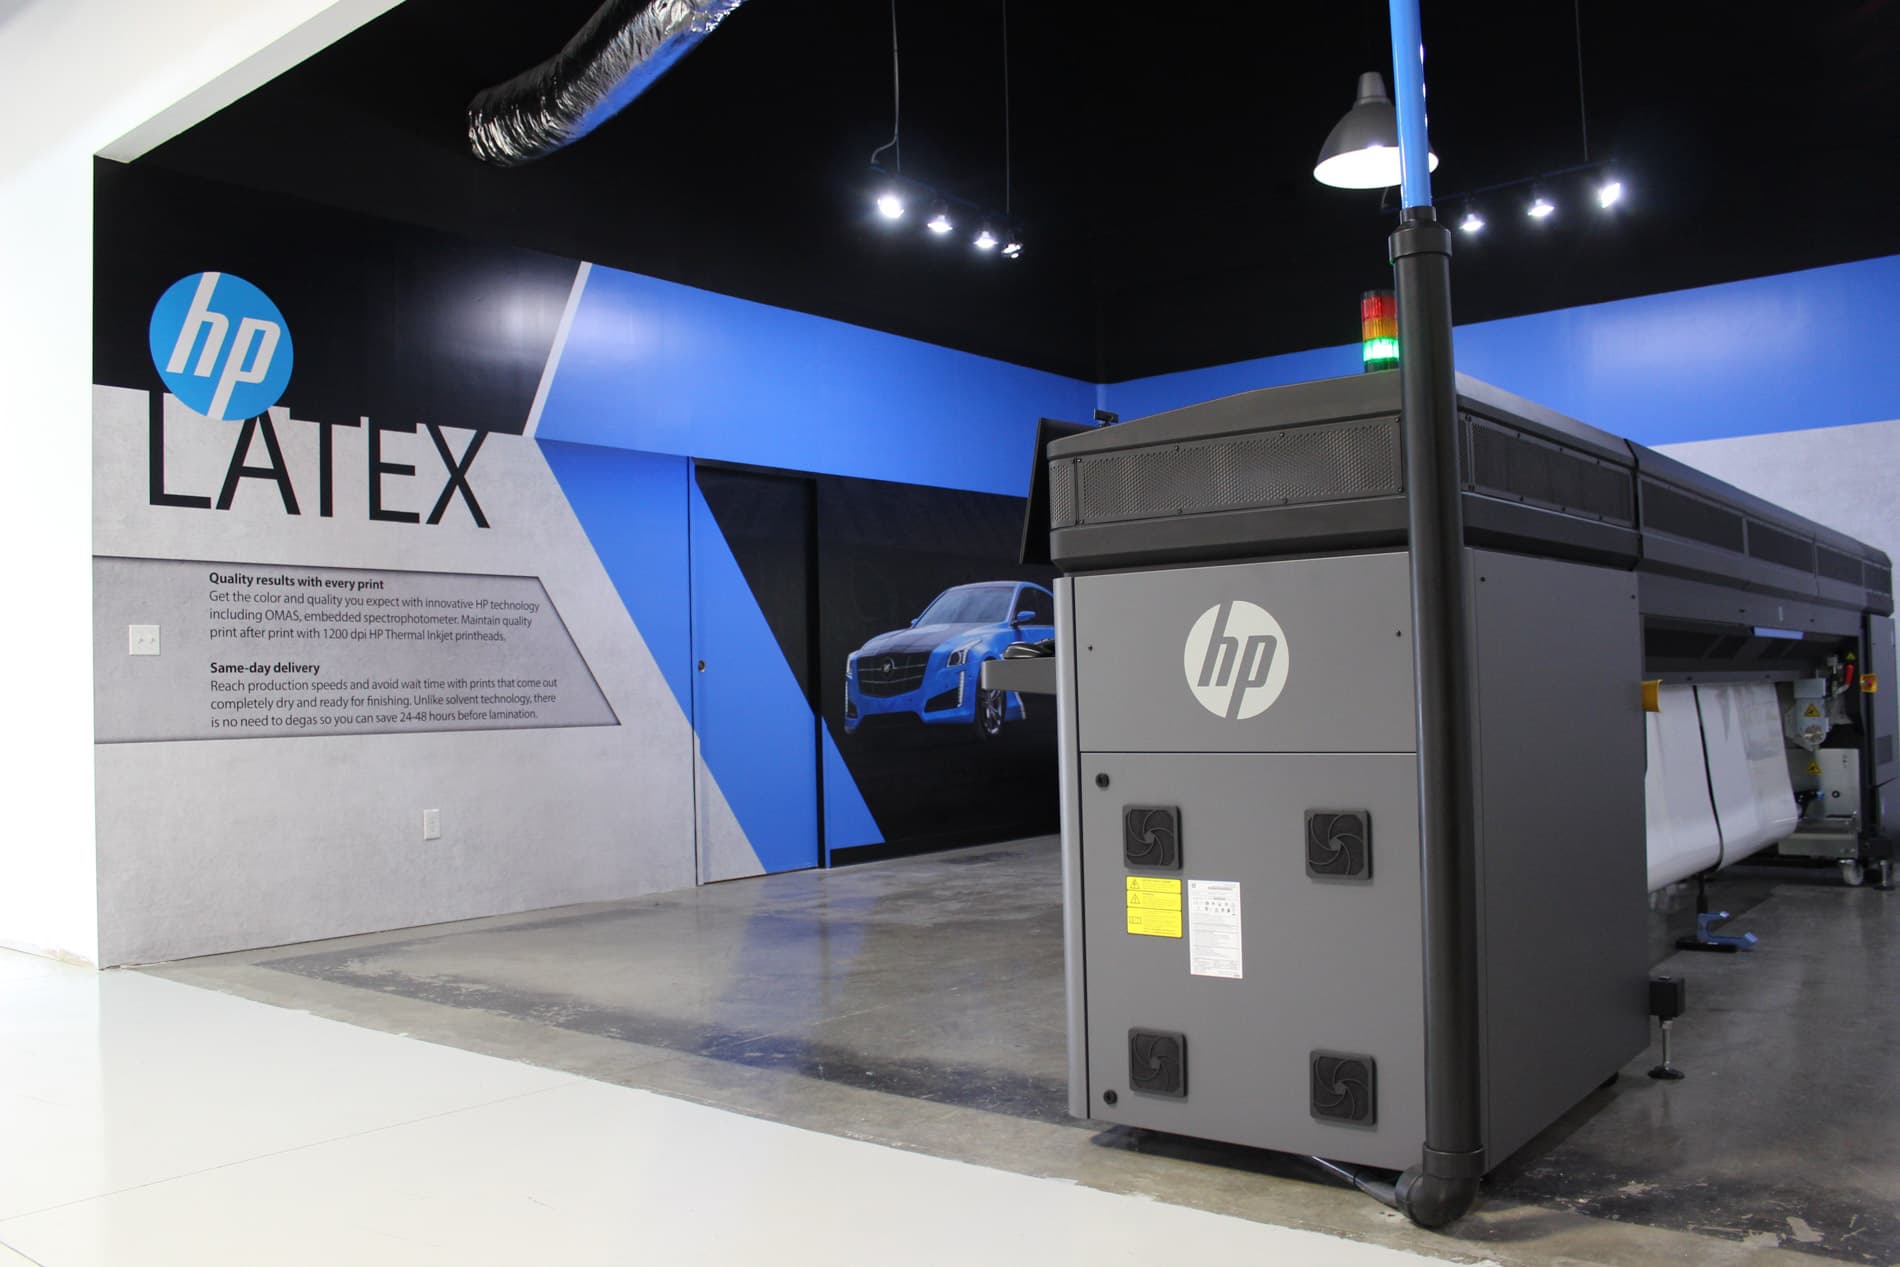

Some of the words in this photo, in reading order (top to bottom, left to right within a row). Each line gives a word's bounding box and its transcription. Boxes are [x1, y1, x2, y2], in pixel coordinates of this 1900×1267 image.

[166, 272, 281, 421] hp
[149, 386, 491, 528] LATEX
[209, 572, 253, 587] Quality
[257, 575, 295, 586] results
[298, 576, 322, 587] with
[325, 579, 355, 591] every
[358, 578, 384, 591] print
[209, 591, 230, 602] Get
[233, 591, 250, 602] the
[254, 592, 280, 603] color
[284, 593, 304, 604] and
[307, 595, 342, 607] quality
[345, 597, 363, 607] you
[366, 598, 400, 608] expect
[402, 597, 423, 608] with
[425, 597, 474, 609] innovative
[476, 600, 488, 609] HP
[491, 600, 539, 613] technology
[209, 609, 262, 623] including
[265, 610, 302, 622] OMAS,
[304, 611, 361, 623] embedded
[364, 614, 459, 626] spectrophotometer.
[461, 616, 500, 625] Maintain
[502, 616, 532, 628] quality
[210, 628, 236, 639] print
[240, 627, 265, 638] after
[268, 628, 293, 640] print
[297, 629, 320, 639] with
[323, 629, 348, 639] 1200
[351, 630, 367, 640] dpi
[370, 630, 383, 639] HP
[386, 629, 425, 640] Thermal
[427, 630, 453, 643] Inkjet
[456, 631, 506, 642] printheads.
[210, 662, 270, 675] Same-day
[274, 662, 320, 675] delivery
[1197, 601, 1278, 720] hp
[211, 680, 245, 691] Reach
[248, 680, 308, 693] production
[312, 680, 347, 692] speeds
[350, 680, 369, 689] and
[372, 679, 399, 689] avoid
[401, 679, 421, 689] wait
[424, 679, 445, 689] time
[448, 678, 467, 688] with
[470, 679, 496, 690] prints
[498, 678, 515, 688] that
[517, 680, 541, 688] come
[543, 679, 557, 687] out
[211, 697, 273, 712] completely
[276, 697, 294, 710] dry
[297, 697, 317, 708] and
[320, 697, 348, 709] ready
[350, 696, 364, 706] for
[367, 696, 412, 708] finishing.
[414, 695, 443, 705] Unlike
[446, 694, 478, 705] solvent
[481, 694, 532, 705] technology,
[534, 693, 556, 703] there
[211, 717, 219, 727] is
[223, 718, 237, 727] no
[241, 715, 268, 726] need
[271, 717, 282, 726] to
[285, 715, 317, 728] degas
[334, 715, 352, 727] you
[356, 714, 373, 723] can
[376, 713, 397, 722] save
[400, 712, 426, 722] 24-48
[429, 711, 456, 721] hours
[458, 710, 487, 720] before
[489, 710, 537, 719] lamination.
